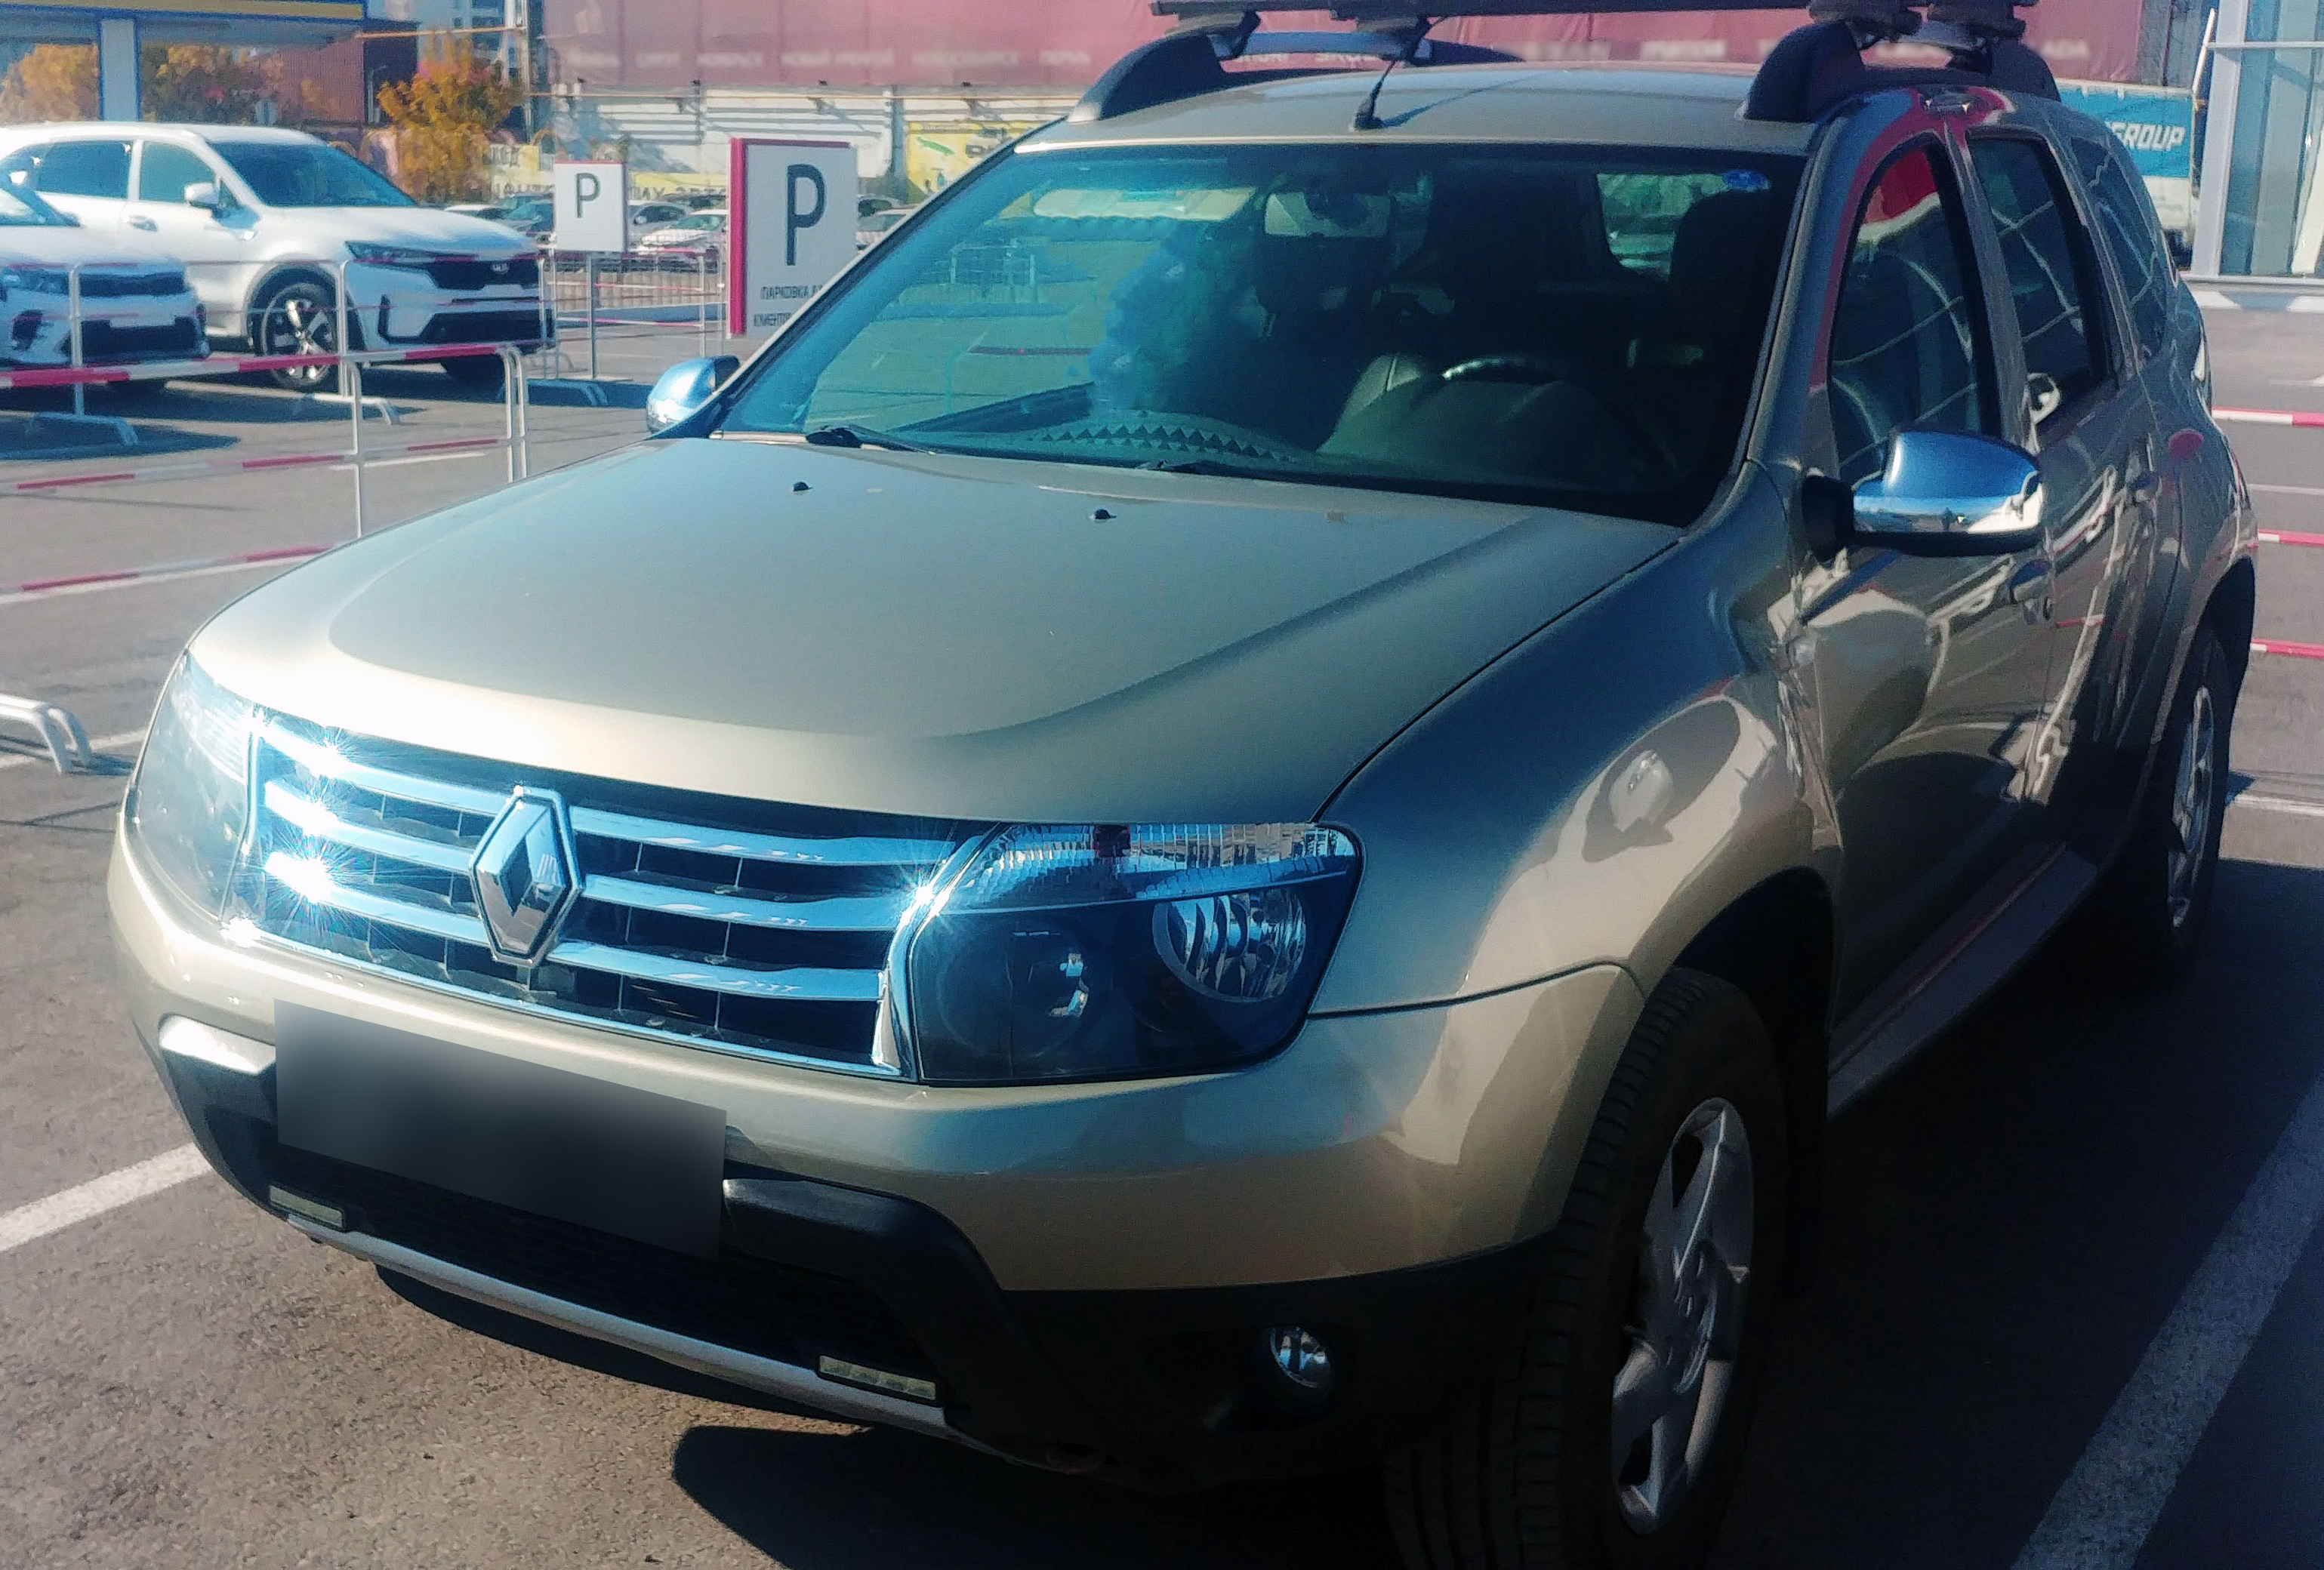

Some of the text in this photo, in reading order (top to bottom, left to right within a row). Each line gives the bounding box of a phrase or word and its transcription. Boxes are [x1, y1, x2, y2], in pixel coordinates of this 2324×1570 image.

[2104, 121, 2186, 151] GROUP
[576, 173, 600, 218] P
[787, 164, 825, 266] P
